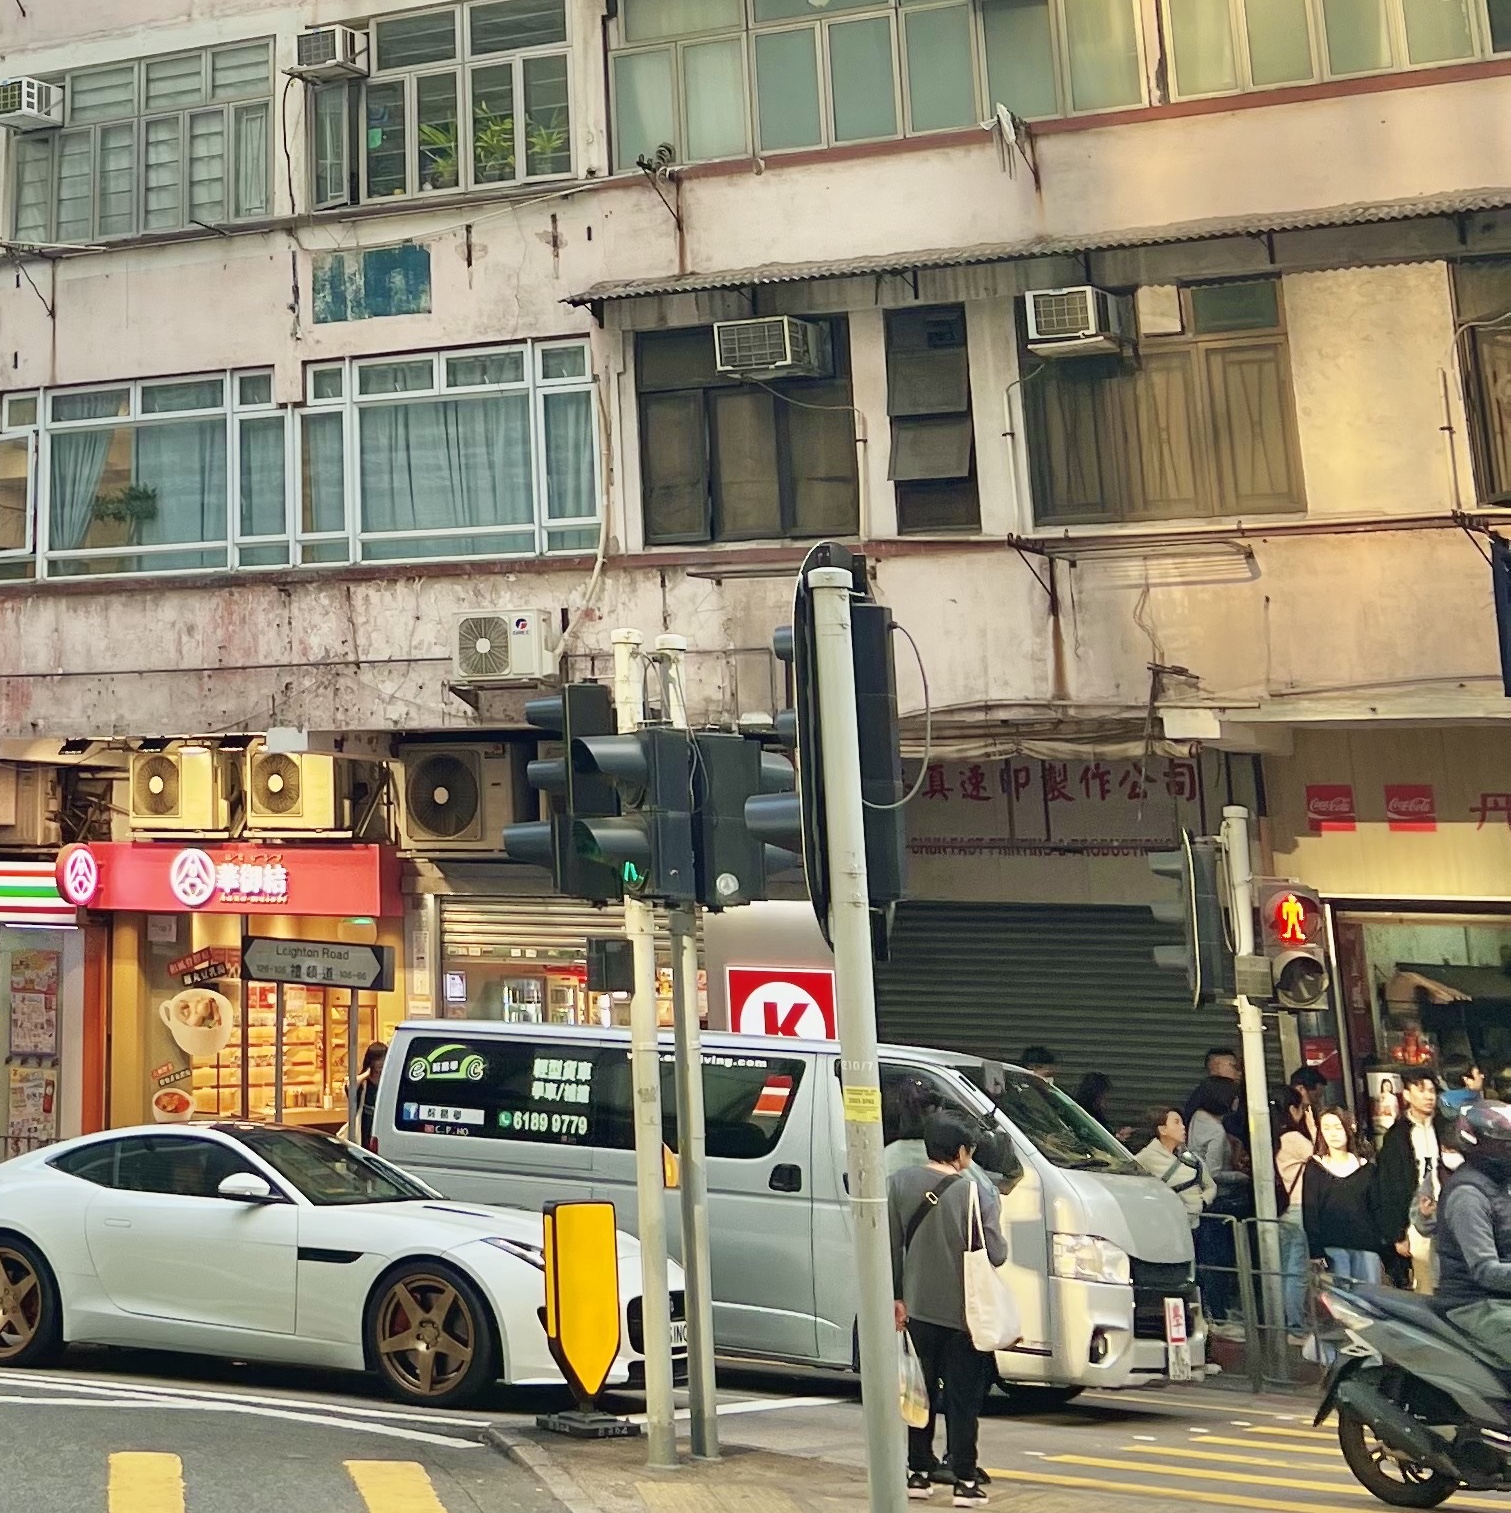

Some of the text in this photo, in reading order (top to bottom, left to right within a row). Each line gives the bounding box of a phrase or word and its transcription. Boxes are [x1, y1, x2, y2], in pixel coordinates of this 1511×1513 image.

[904, 761, 1198, 802] 真速印製作公司
[216, 863, 286, 893] 華御結
[276, 945, 350, 960] Leighton Road
[290, 963, 334, 981] 禮頓道
[763, 1001, 810, 1036] K
[513, 1110, 588, 1136] 6189 9779
